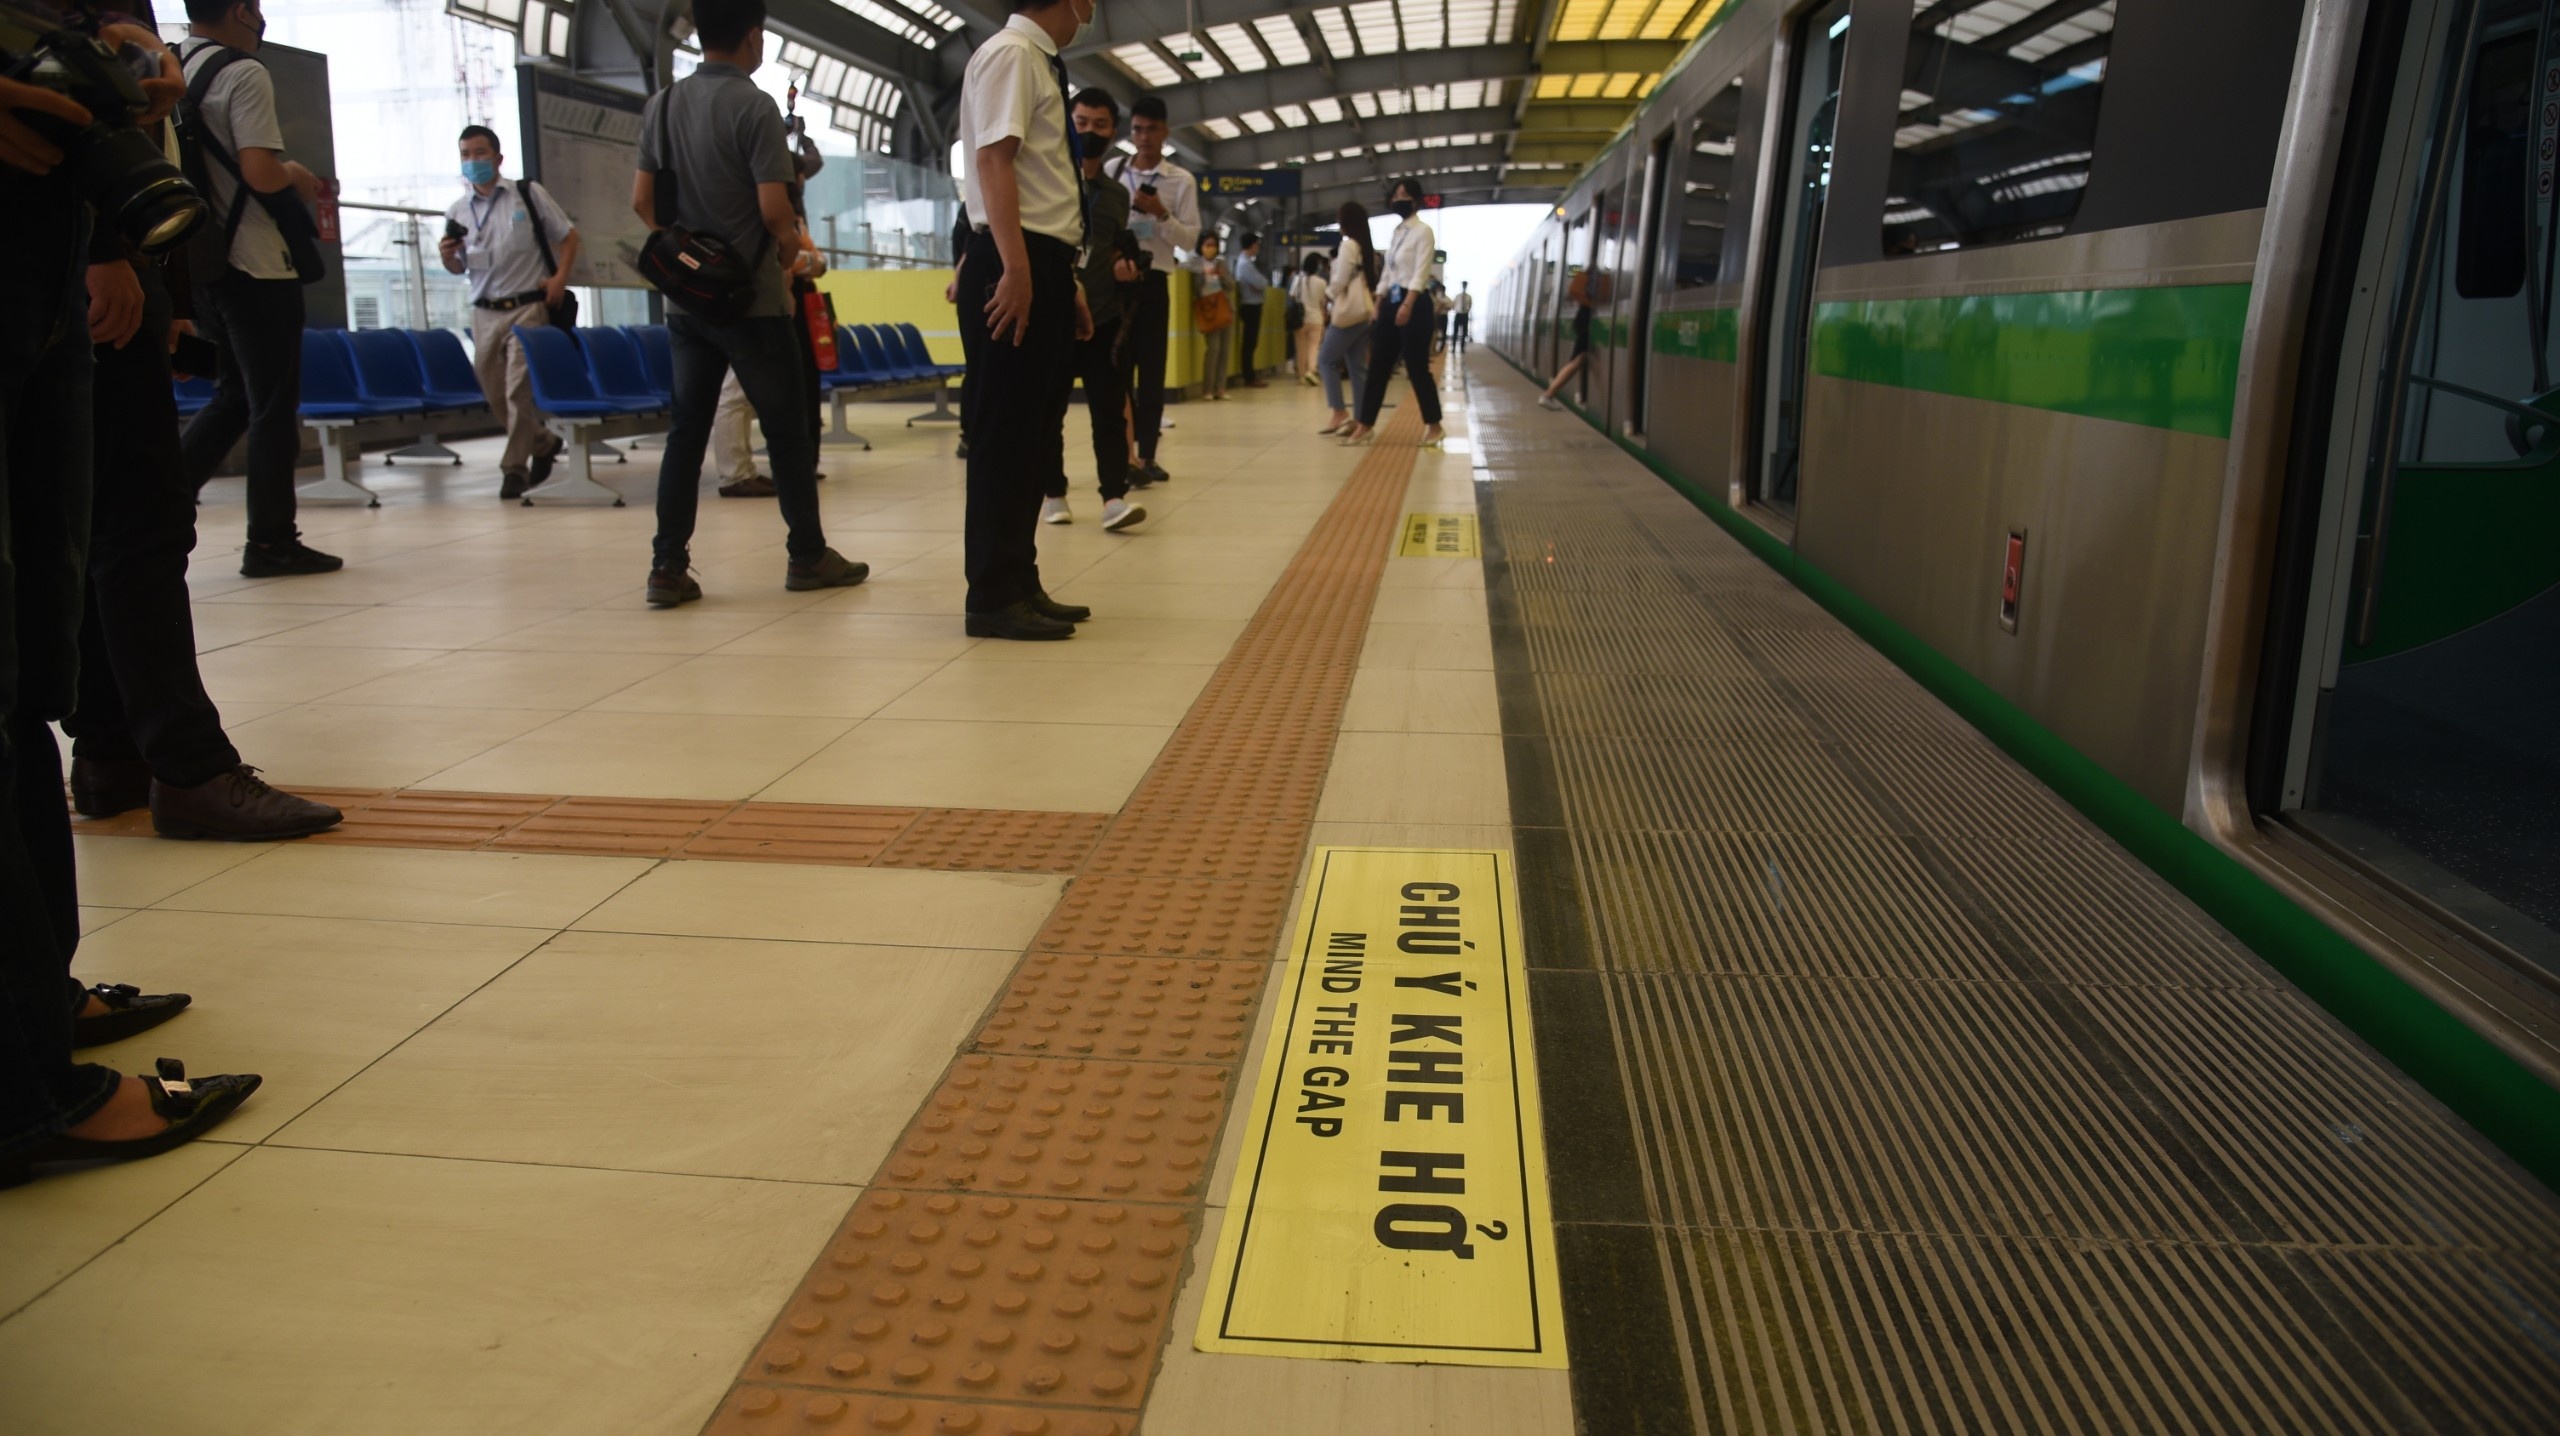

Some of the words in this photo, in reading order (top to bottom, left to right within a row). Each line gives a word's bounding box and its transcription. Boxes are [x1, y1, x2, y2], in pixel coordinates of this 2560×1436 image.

[1395, 882, 1475, 956] CHÚ
[1322, 932, 1367, 994] MIND
[1394, 971, 1477, 997] Ý
[1308, 1002, 1358, 1056] THE
[1295, 1066, 1349, 1138] GAP
[1384, 1013, 1465, 1124] KHE
[1373, 1150, 1508, 1260] HỞ
